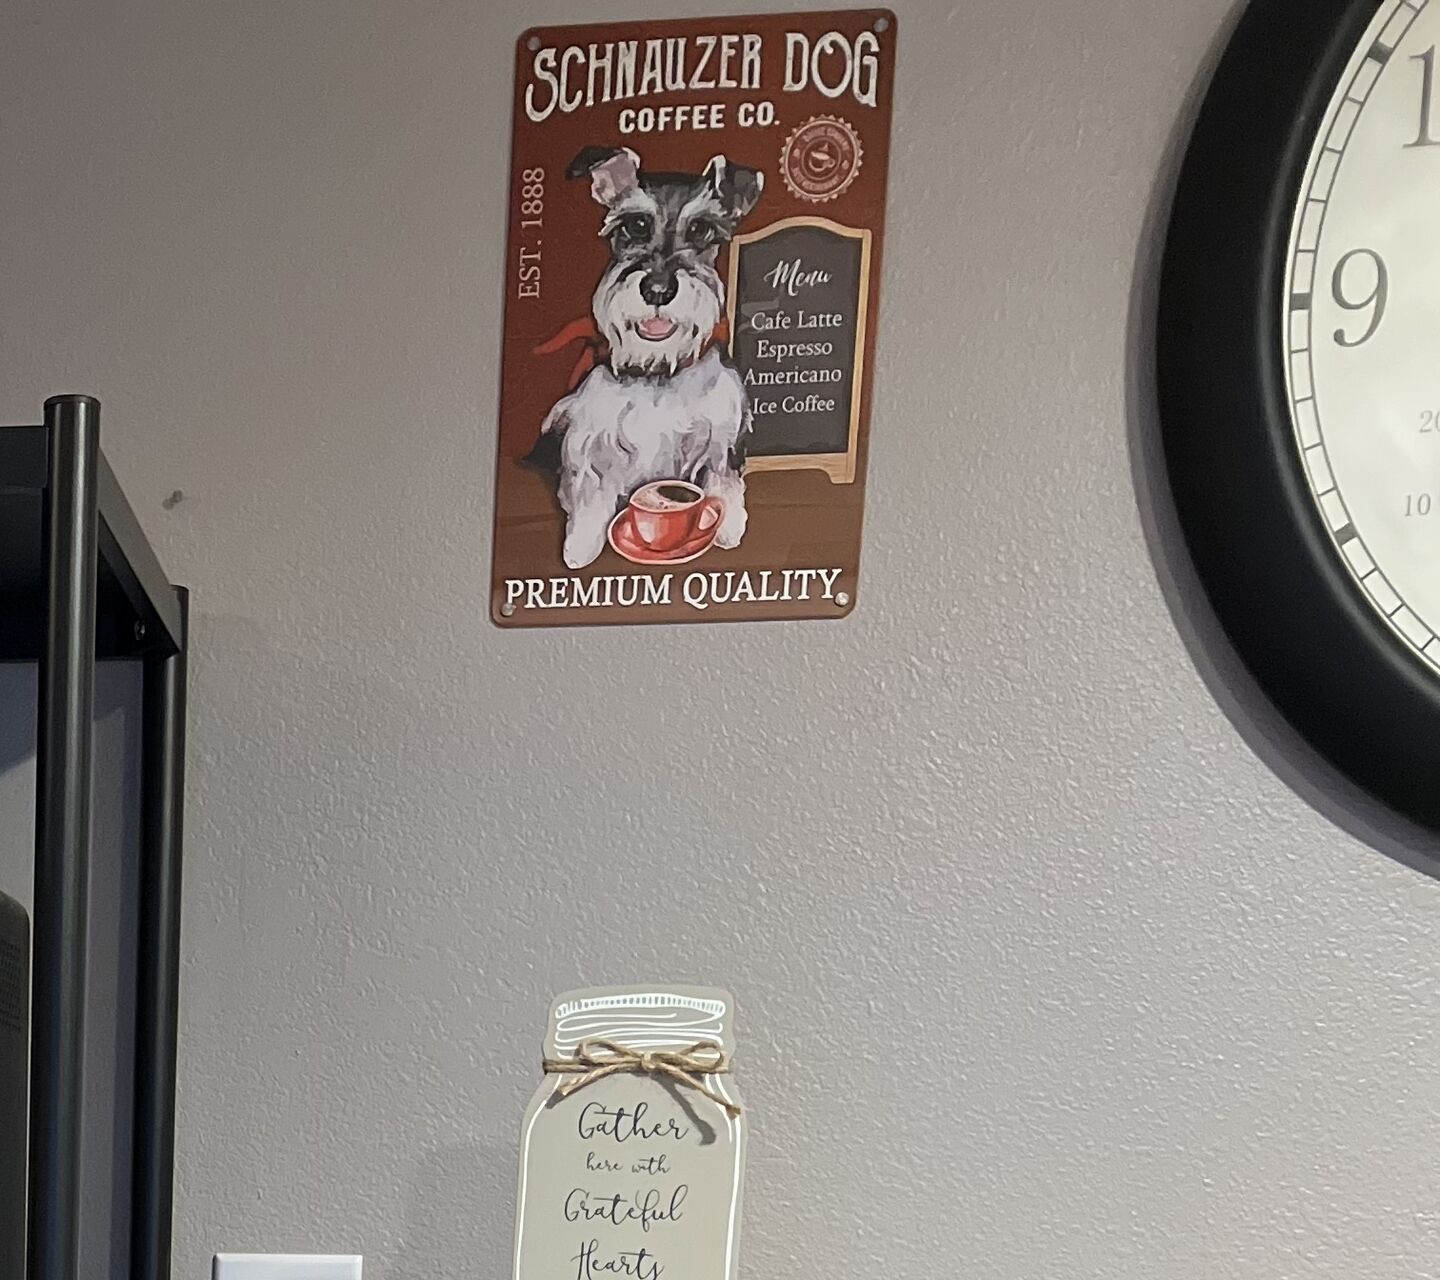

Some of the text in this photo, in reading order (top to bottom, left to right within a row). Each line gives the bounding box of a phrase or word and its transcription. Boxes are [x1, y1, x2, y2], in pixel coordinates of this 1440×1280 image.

[524, 31, 880, 123] SCHNAUZER DOG
[618, 101, 781, 134] COFFEE CO.
[517, 166, 546, 300] EST. 1888
[763, 258, 833, 298] Menu
[1331, 248, 1389, 348] 9
[751, 309, 843, 331] Cafe Latte
[756, 339, 833, 360] Espresso
[743, 365, 842, 386] Americano
[753, 395, 835, 415] Ice Coffee
[1405, 493, 1431, 517] 10
[505, 568, 842, 609] PREMIUM QUALITY
[578, 1102, 690, 1143] Gather
[586, 1152, 671, 1174] here with
[565, 1184, 688, 1232] Grateful
